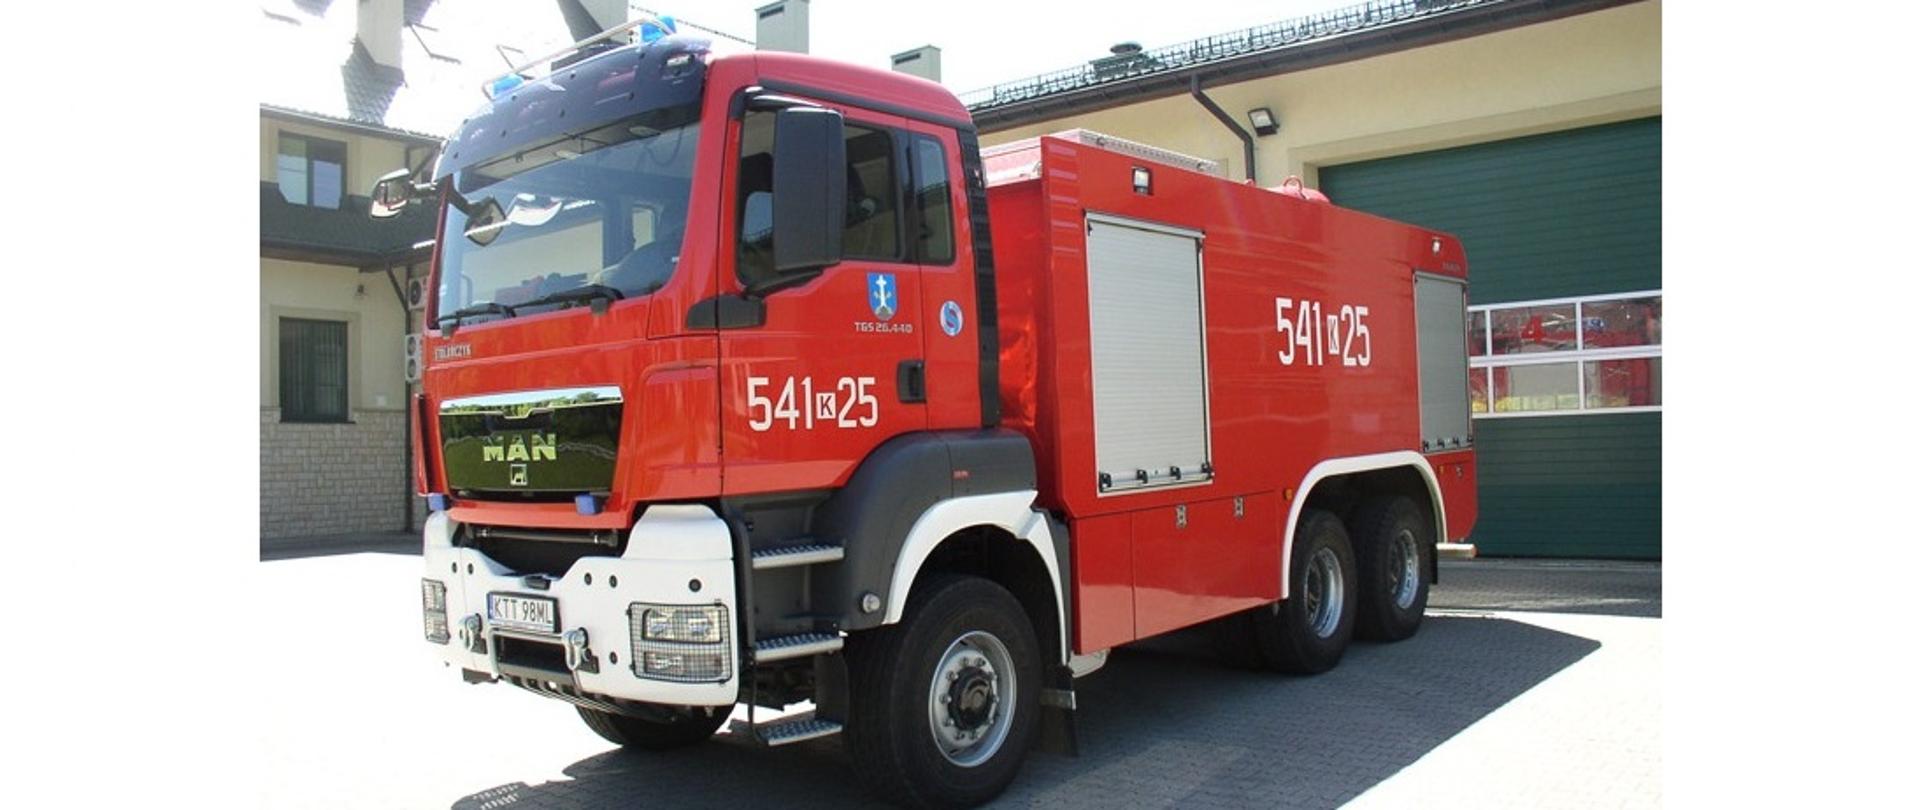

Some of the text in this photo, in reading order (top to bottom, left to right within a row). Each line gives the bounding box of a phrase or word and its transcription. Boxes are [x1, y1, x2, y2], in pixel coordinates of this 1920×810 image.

[854, 322, 913, 334] TGS 26.440
[1275, 297, 1323, 366] 541
[1340, 304, 1371, 366] 25
[747, 376, 878, 431] 541 K 25
[482, 433, 557, 462] MAN
[494, 598, 553, 624] KTT 98ML
